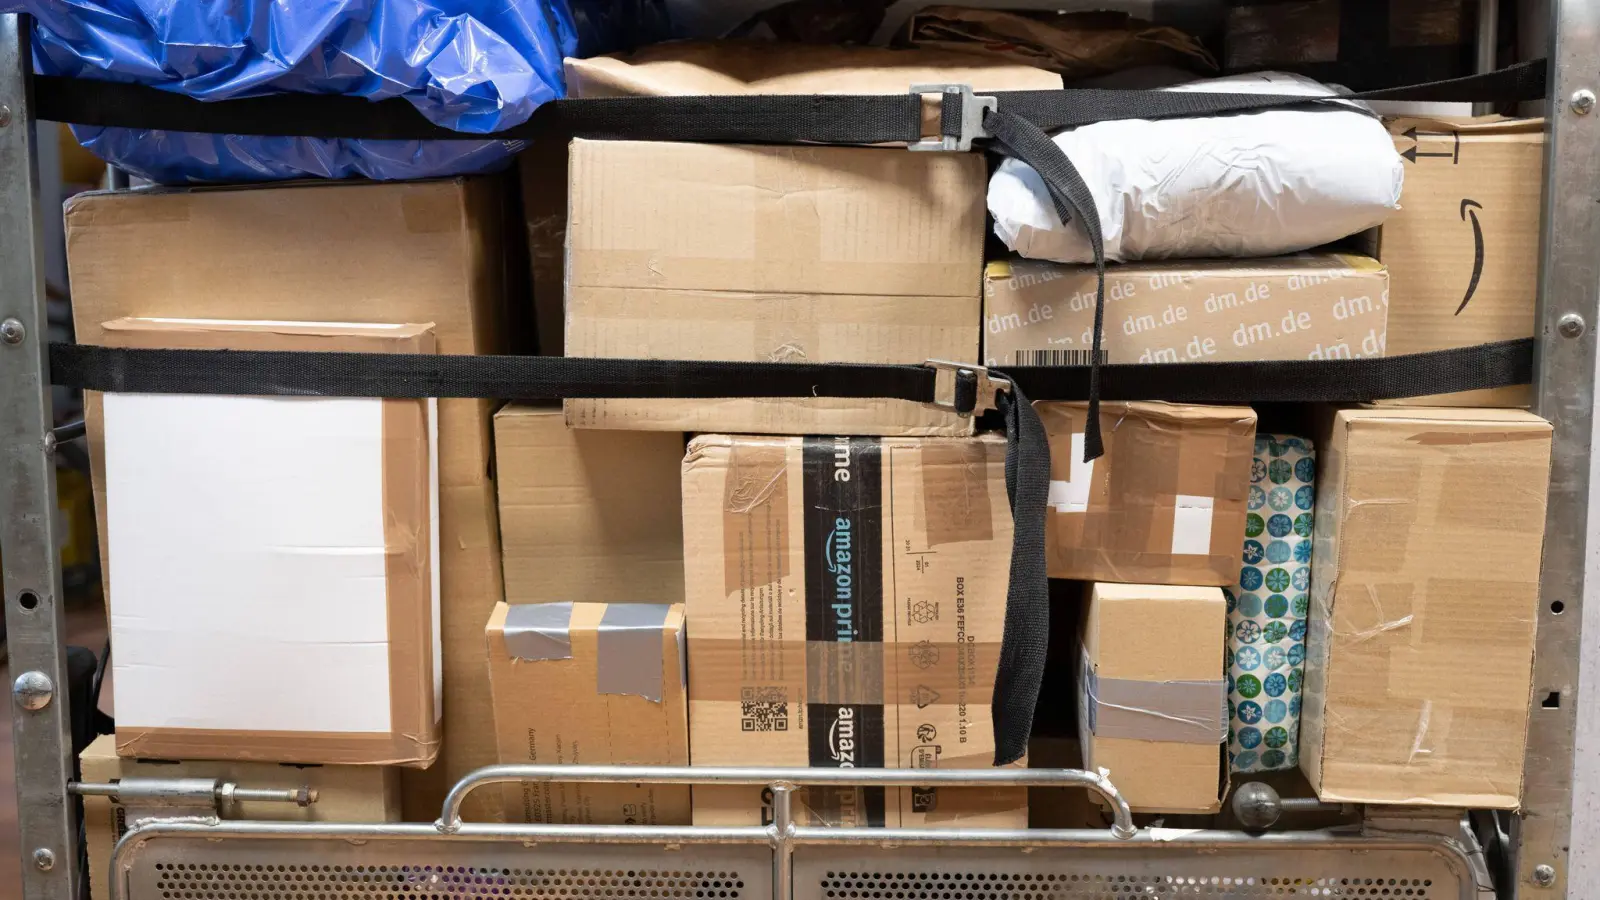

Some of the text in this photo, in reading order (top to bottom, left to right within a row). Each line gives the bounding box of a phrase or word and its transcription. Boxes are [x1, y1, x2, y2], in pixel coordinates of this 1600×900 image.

[988, 302, 1053, 334] dm.de
[1070, 280, 1136, 312] dm.de
[1123, 304, 1188, 336] dm.de
[1204, 281, 1270, 313] dm.de
[1138, 335, 1217, 364] dm.de
[1232, 309, 1312, 347] dm.de
[1332, 289, 1389, 321] dm.
[835, 517, 852, 599] amazon
[956, 577, 965, 596] BOX
[957, 597, 965, 614] E36
[957, 615, 965, 644] FEFCO
[959, 718, 967, 735] 1.10
[527, 727, 537, 761] Germany
